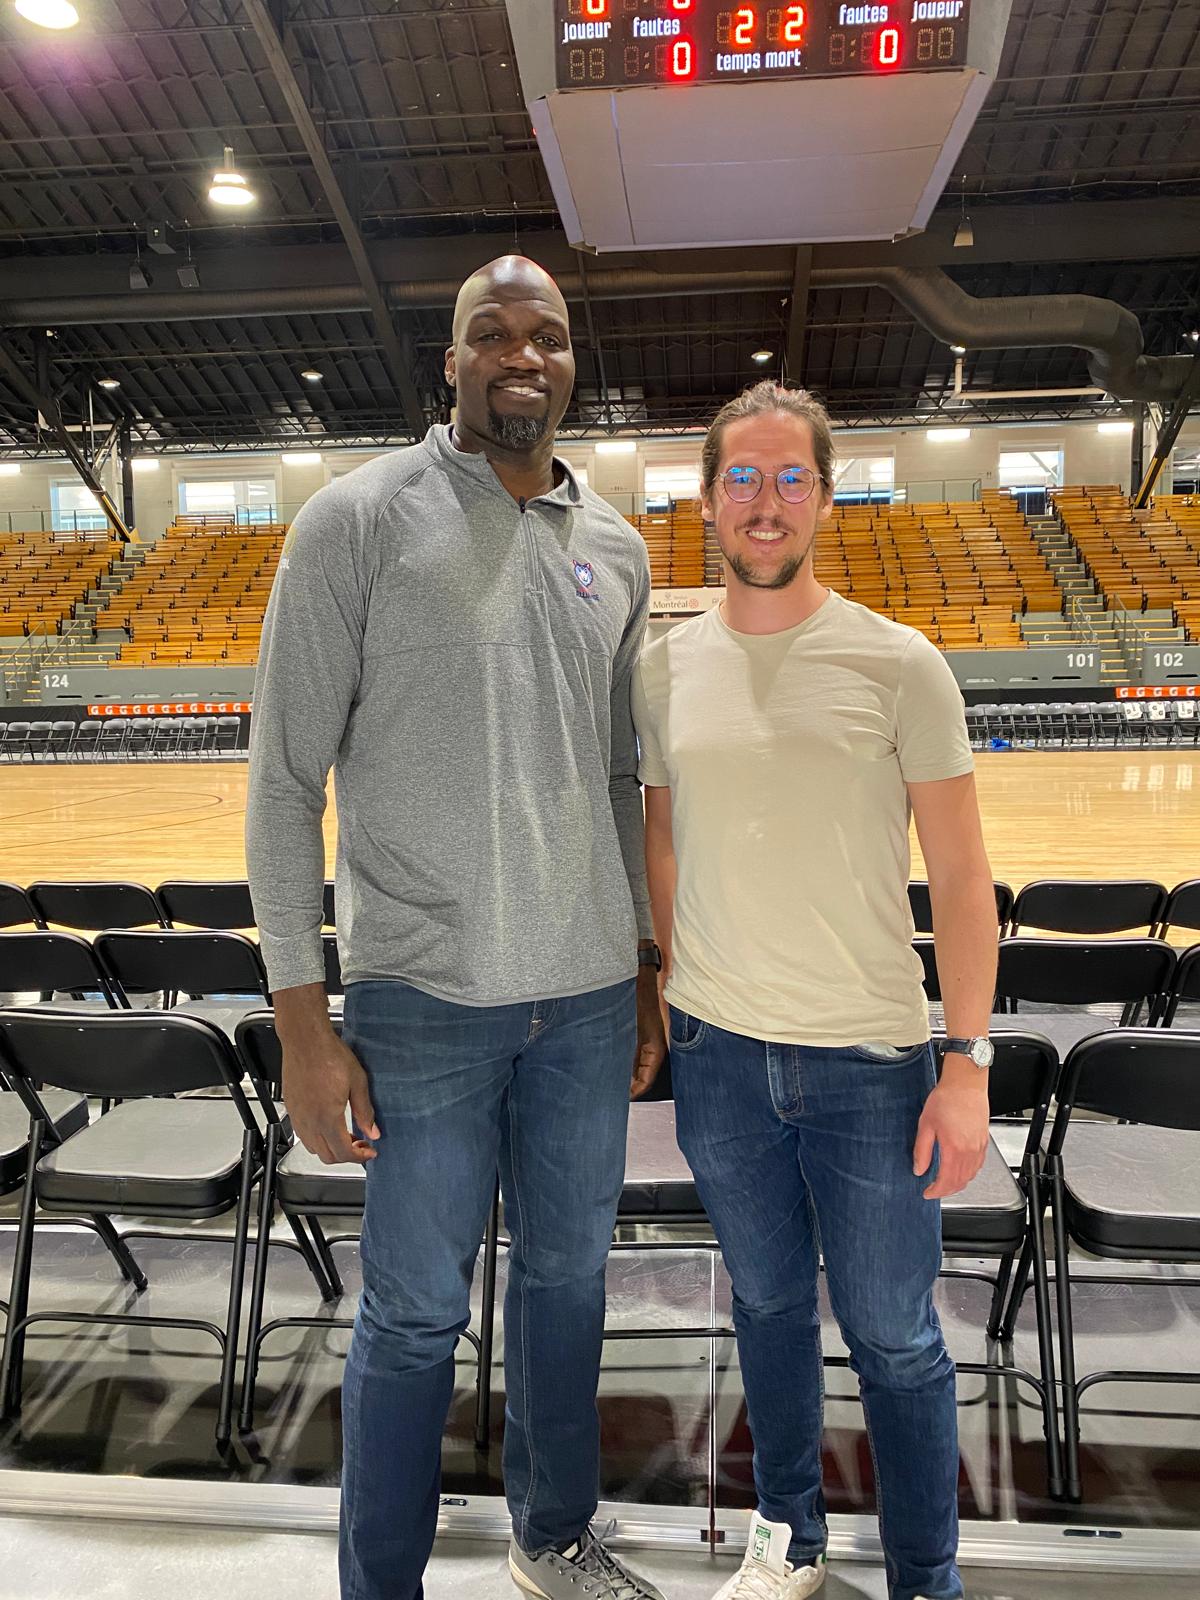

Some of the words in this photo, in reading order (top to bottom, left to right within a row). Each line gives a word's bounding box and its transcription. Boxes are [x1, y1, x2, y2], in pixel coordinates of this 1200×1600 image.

[840, 4, 888, 25] fautes
[911, 0, 963, 23] joueur
[562, 22, 611, 44] joueur
[633, 17, 680, 37] fautes
[735, 9, 754, 44] 2
[785, 6, 804, 41] 2
[879, 29, 898, 64] 0
[673, 42, 691, 75] 0
[717, 53, 760, 73] temps
[765, 48, 801, 68] mort
[653, 600, 688, 609] Montréal
[1067, 653, 1094, 668] 101
[1154, 653, 1184, 667] 102
[43, 674, 69, 688] 124
[1120, 688, 1128, 697] G
[1136, 687, 1145, 697] G
[1153, 687, 1162, 697] G
[1170, 687, 1178, 697] G
[1186, 687, 1195, 696] G
[91, 706, 98, 715] G
[105, 706, 112, 715] G
[120, 706, 127, 714] G
[133, 705, 140, 714] G
[147, 705, 155, 714] G
[161, 705, 169, 714] G
[176, 704, 183, 713] G
[190, 704, 197, 713] G
[204, 703, 212, 712] G
[219, 703, 226, 712] G
[233, 703, 241, 712] G
